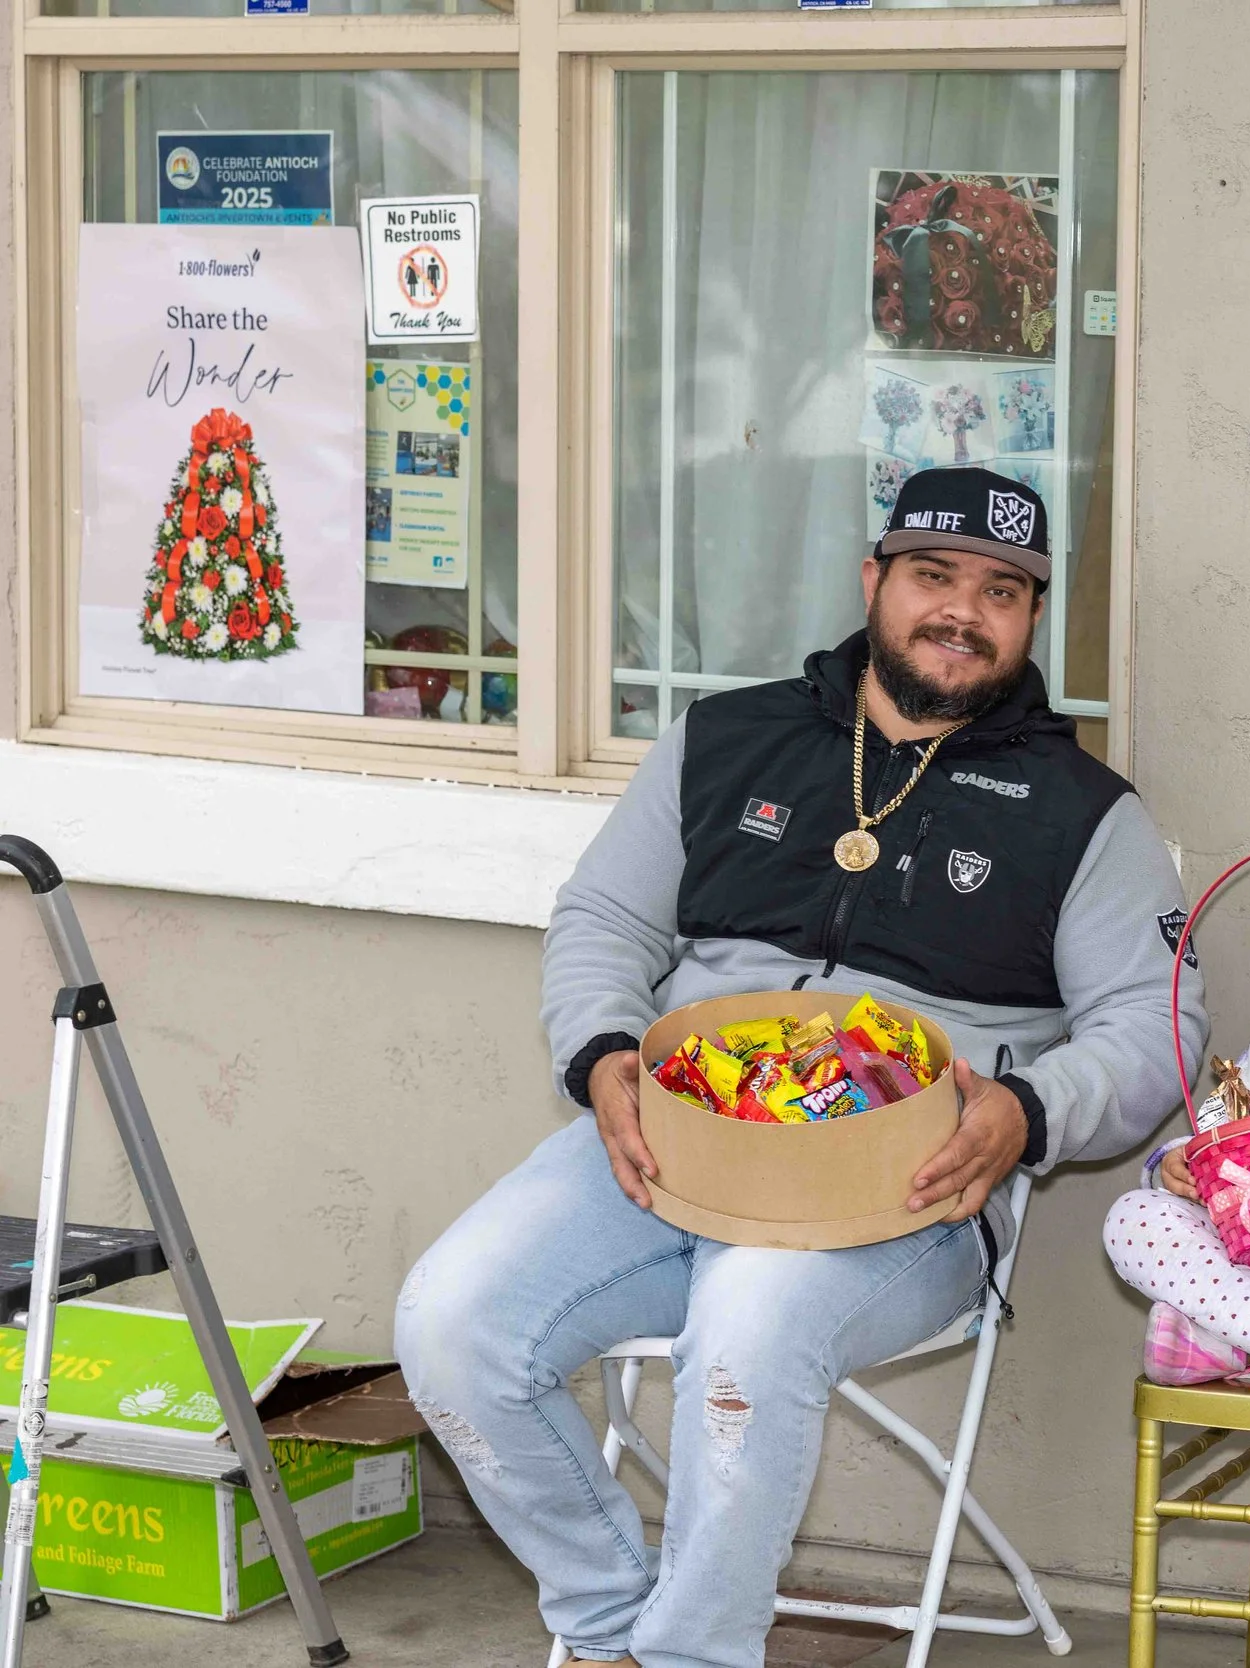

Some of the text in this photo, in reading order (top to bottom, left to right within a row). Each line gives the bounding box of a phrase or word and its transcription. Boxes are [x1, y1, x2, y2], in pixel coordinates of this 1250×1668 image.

[203, 157, 319, 170] CELEBRATE ANTIOCH
[216, 170, 288, 183] FOUNDATION
[221, 187, 273, 209] 2025
[276, 213, 313, 222] EVENTS
[387, 209, 456, 226] No Public
[384, 228, 461, 243] Restrooms
[166, 305, 268, 332] Share the
[389, 311, 462, 333] Thank You
[146, 336, 294, 408] Wonder
[950, 771, 1031, 799] RAIDERS
[744, 817, 780, 834] RAIDERS
[955, 853, 987, 867] RAIDERS
[1161, 915, 1188, 925] RAIDE
[1205, 1096, 1220, 1104] acts
[38, 1492, 165, 1543] reens
[37, 1543, 166, 1578] and Foliage Farm
